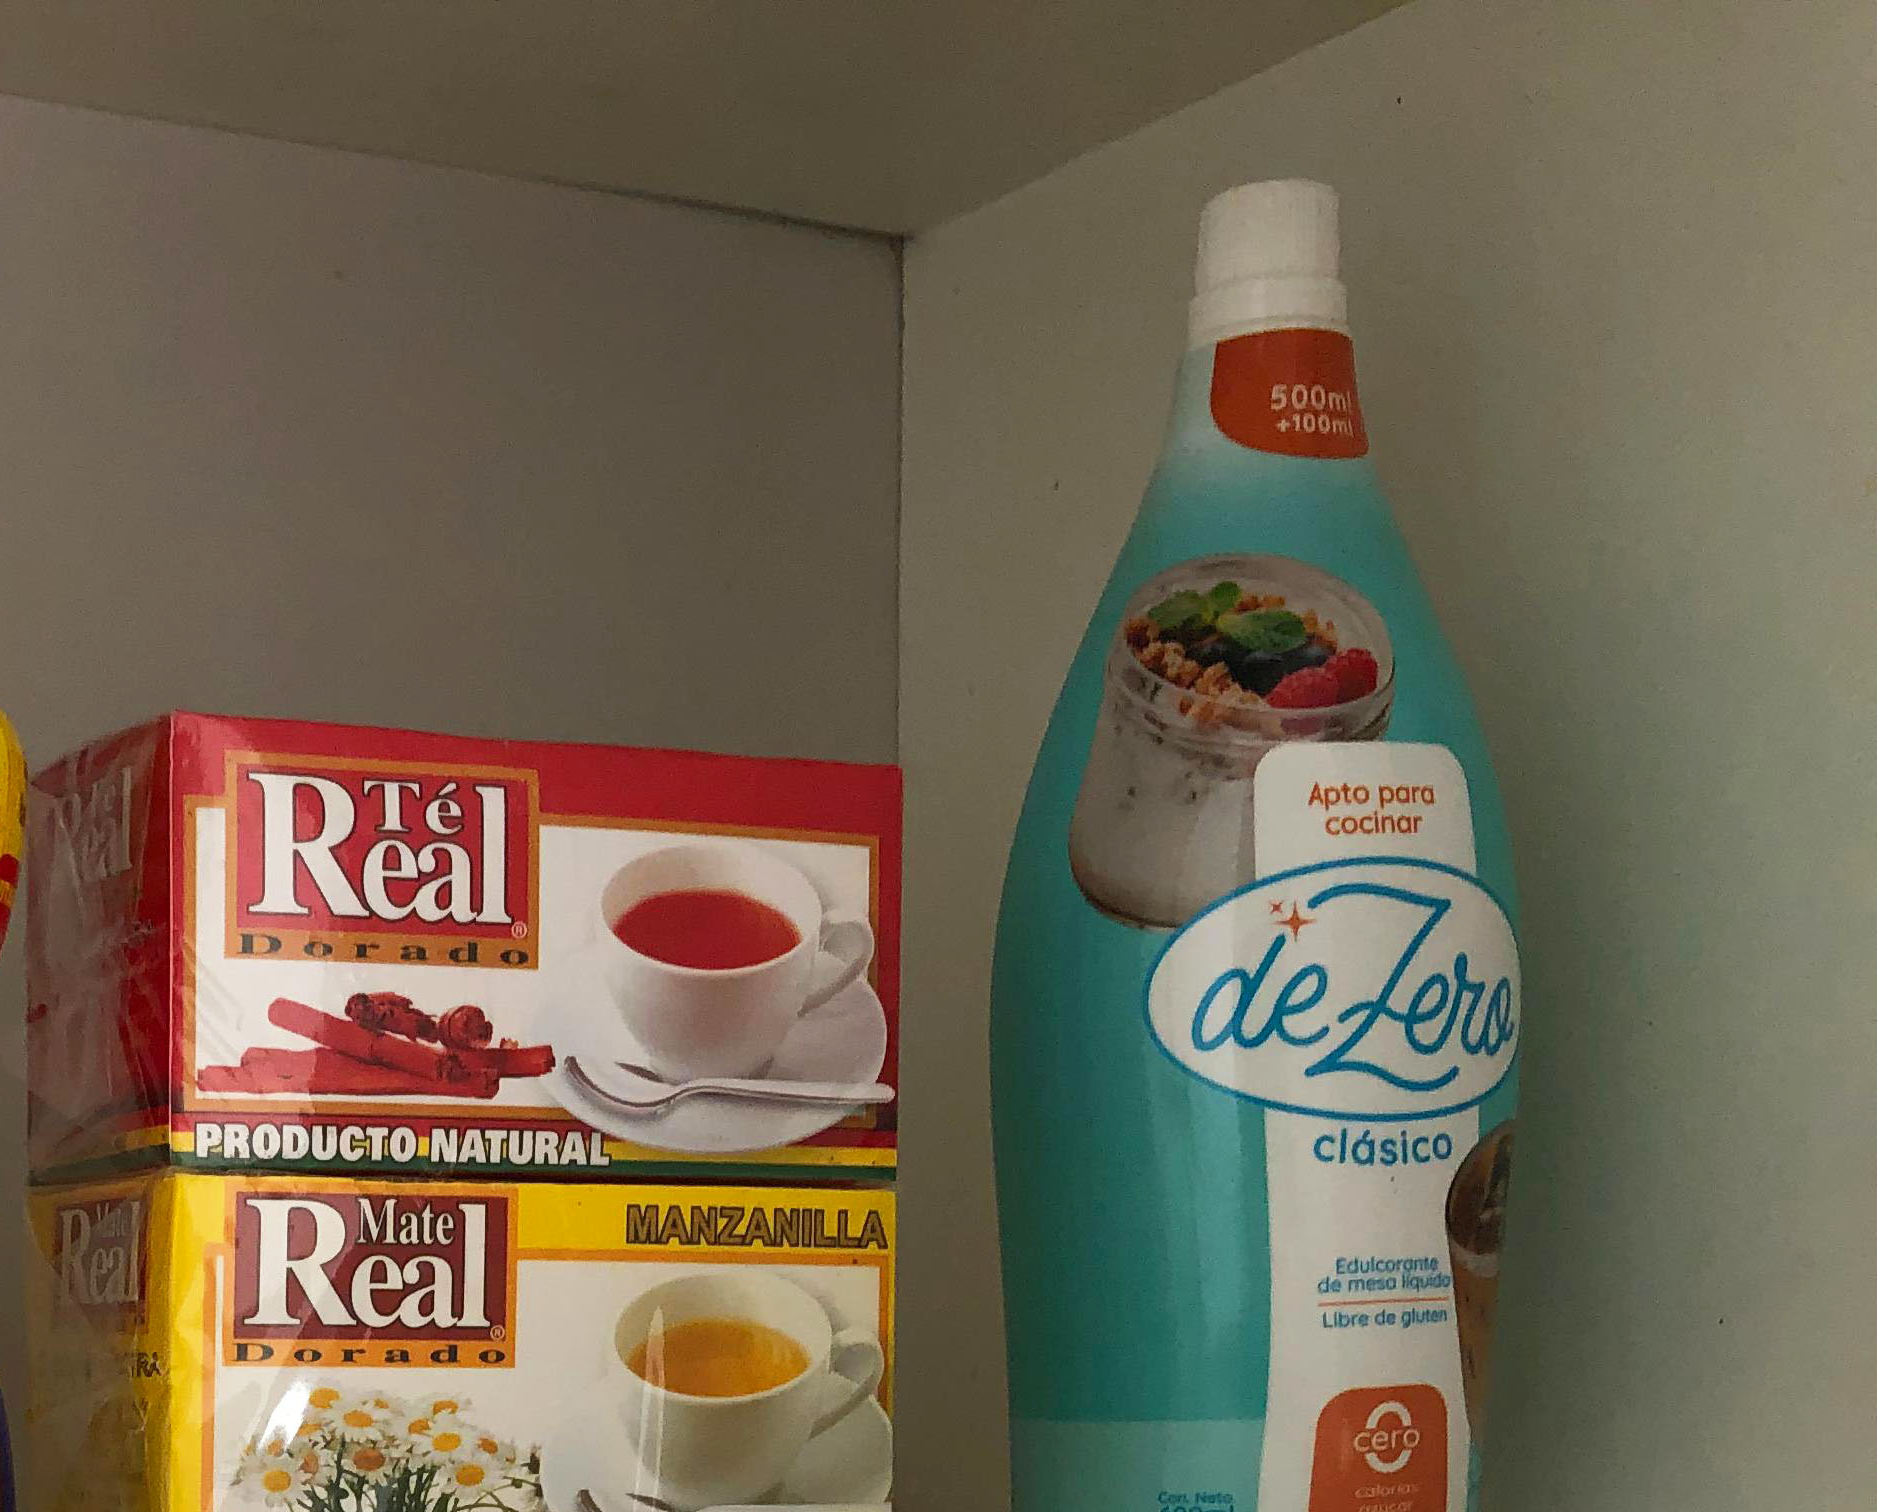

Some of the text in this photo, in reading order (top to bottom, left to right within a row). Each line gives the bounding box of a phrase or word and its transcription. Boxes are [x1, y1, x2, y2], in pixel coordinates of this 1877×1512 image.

[363, 781, 464, 835] Té
[1308, 781, 1435, 811] Apto para
[1325, 810, 1423, 835] cocinar
[247, 771, 513, 926] Real
[241, 932, 530, 967] Dorado
[195, 1122, 612, 1167] PRODUCTO NATURAL
[1313, 1127, 1453, 1167] clásico
[355, 1197, 455, 1246] Mate
[625, 1203, 888, 1250] MANZANILLA
[244, 1197, 490, 1330] Real
[1335, 1255, 1439, 1275] Edulcorante
[1317, 1276, 1342, 1293] de
[1348, 1277, 1397, 1292] mesa
[1322, 1307, 1448, 1329] Libre de gluten
[231, 1342, 506, 1364] Dorado
[1353, 1429, 1420, 1453] cero
